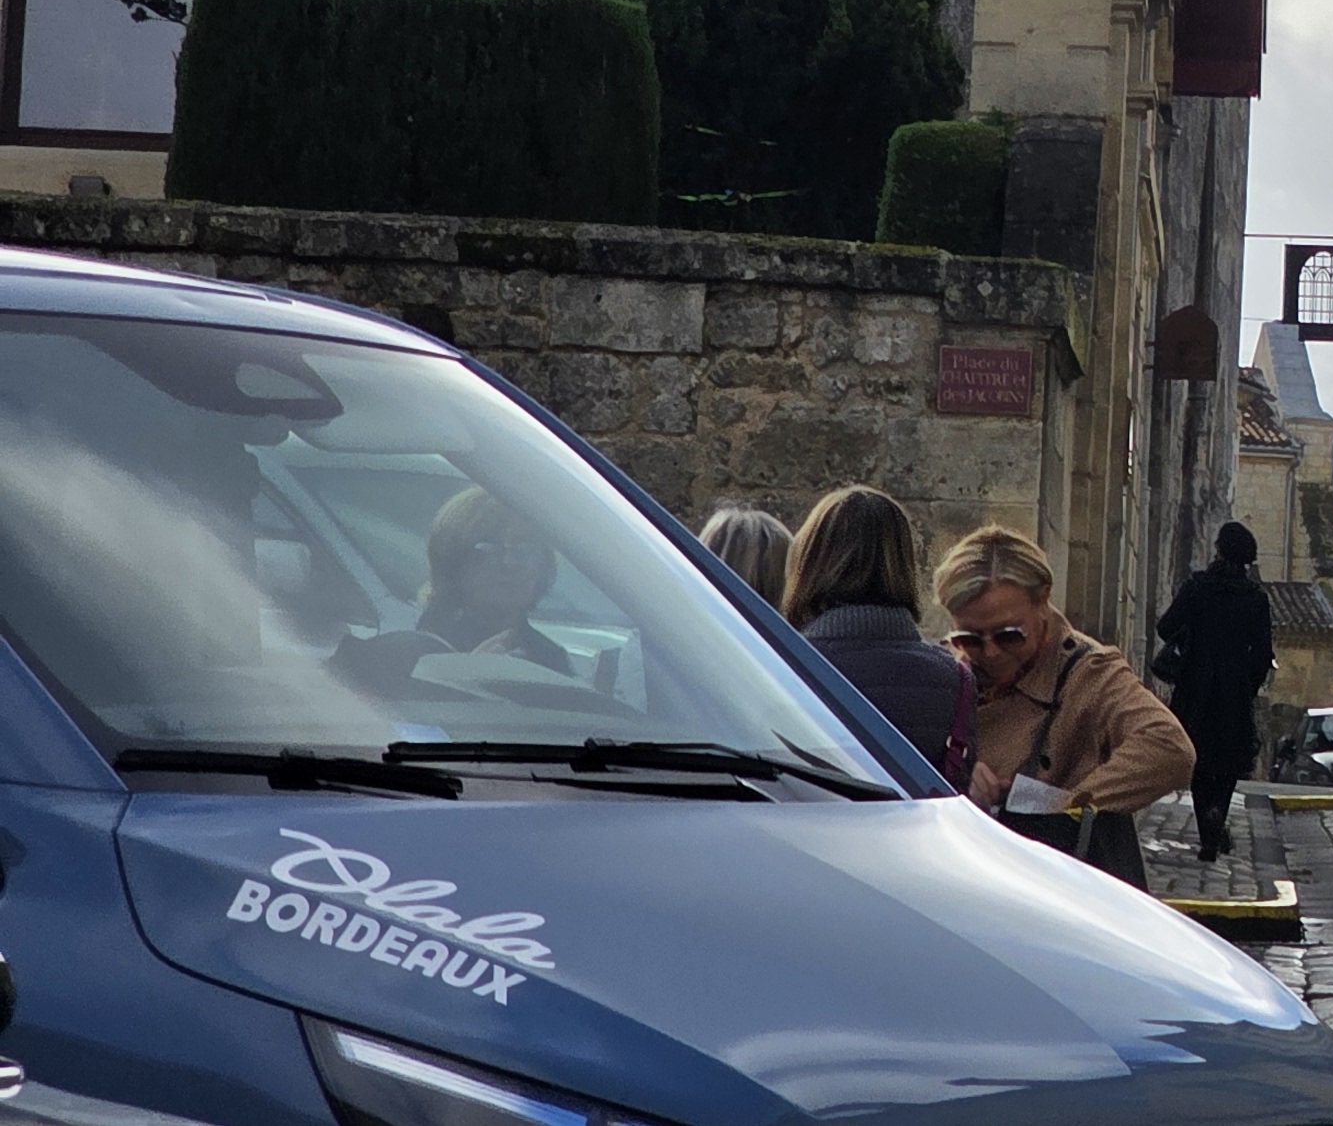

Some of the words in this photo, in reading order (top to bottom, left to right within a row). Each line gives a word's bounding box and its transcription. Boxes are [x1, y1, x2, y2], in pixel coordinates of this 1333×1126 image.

[953, 353, 997, 369] Place
[1000, 356, 1020, 371] du
[226, 878, 527, 1006] BORDEAUX
